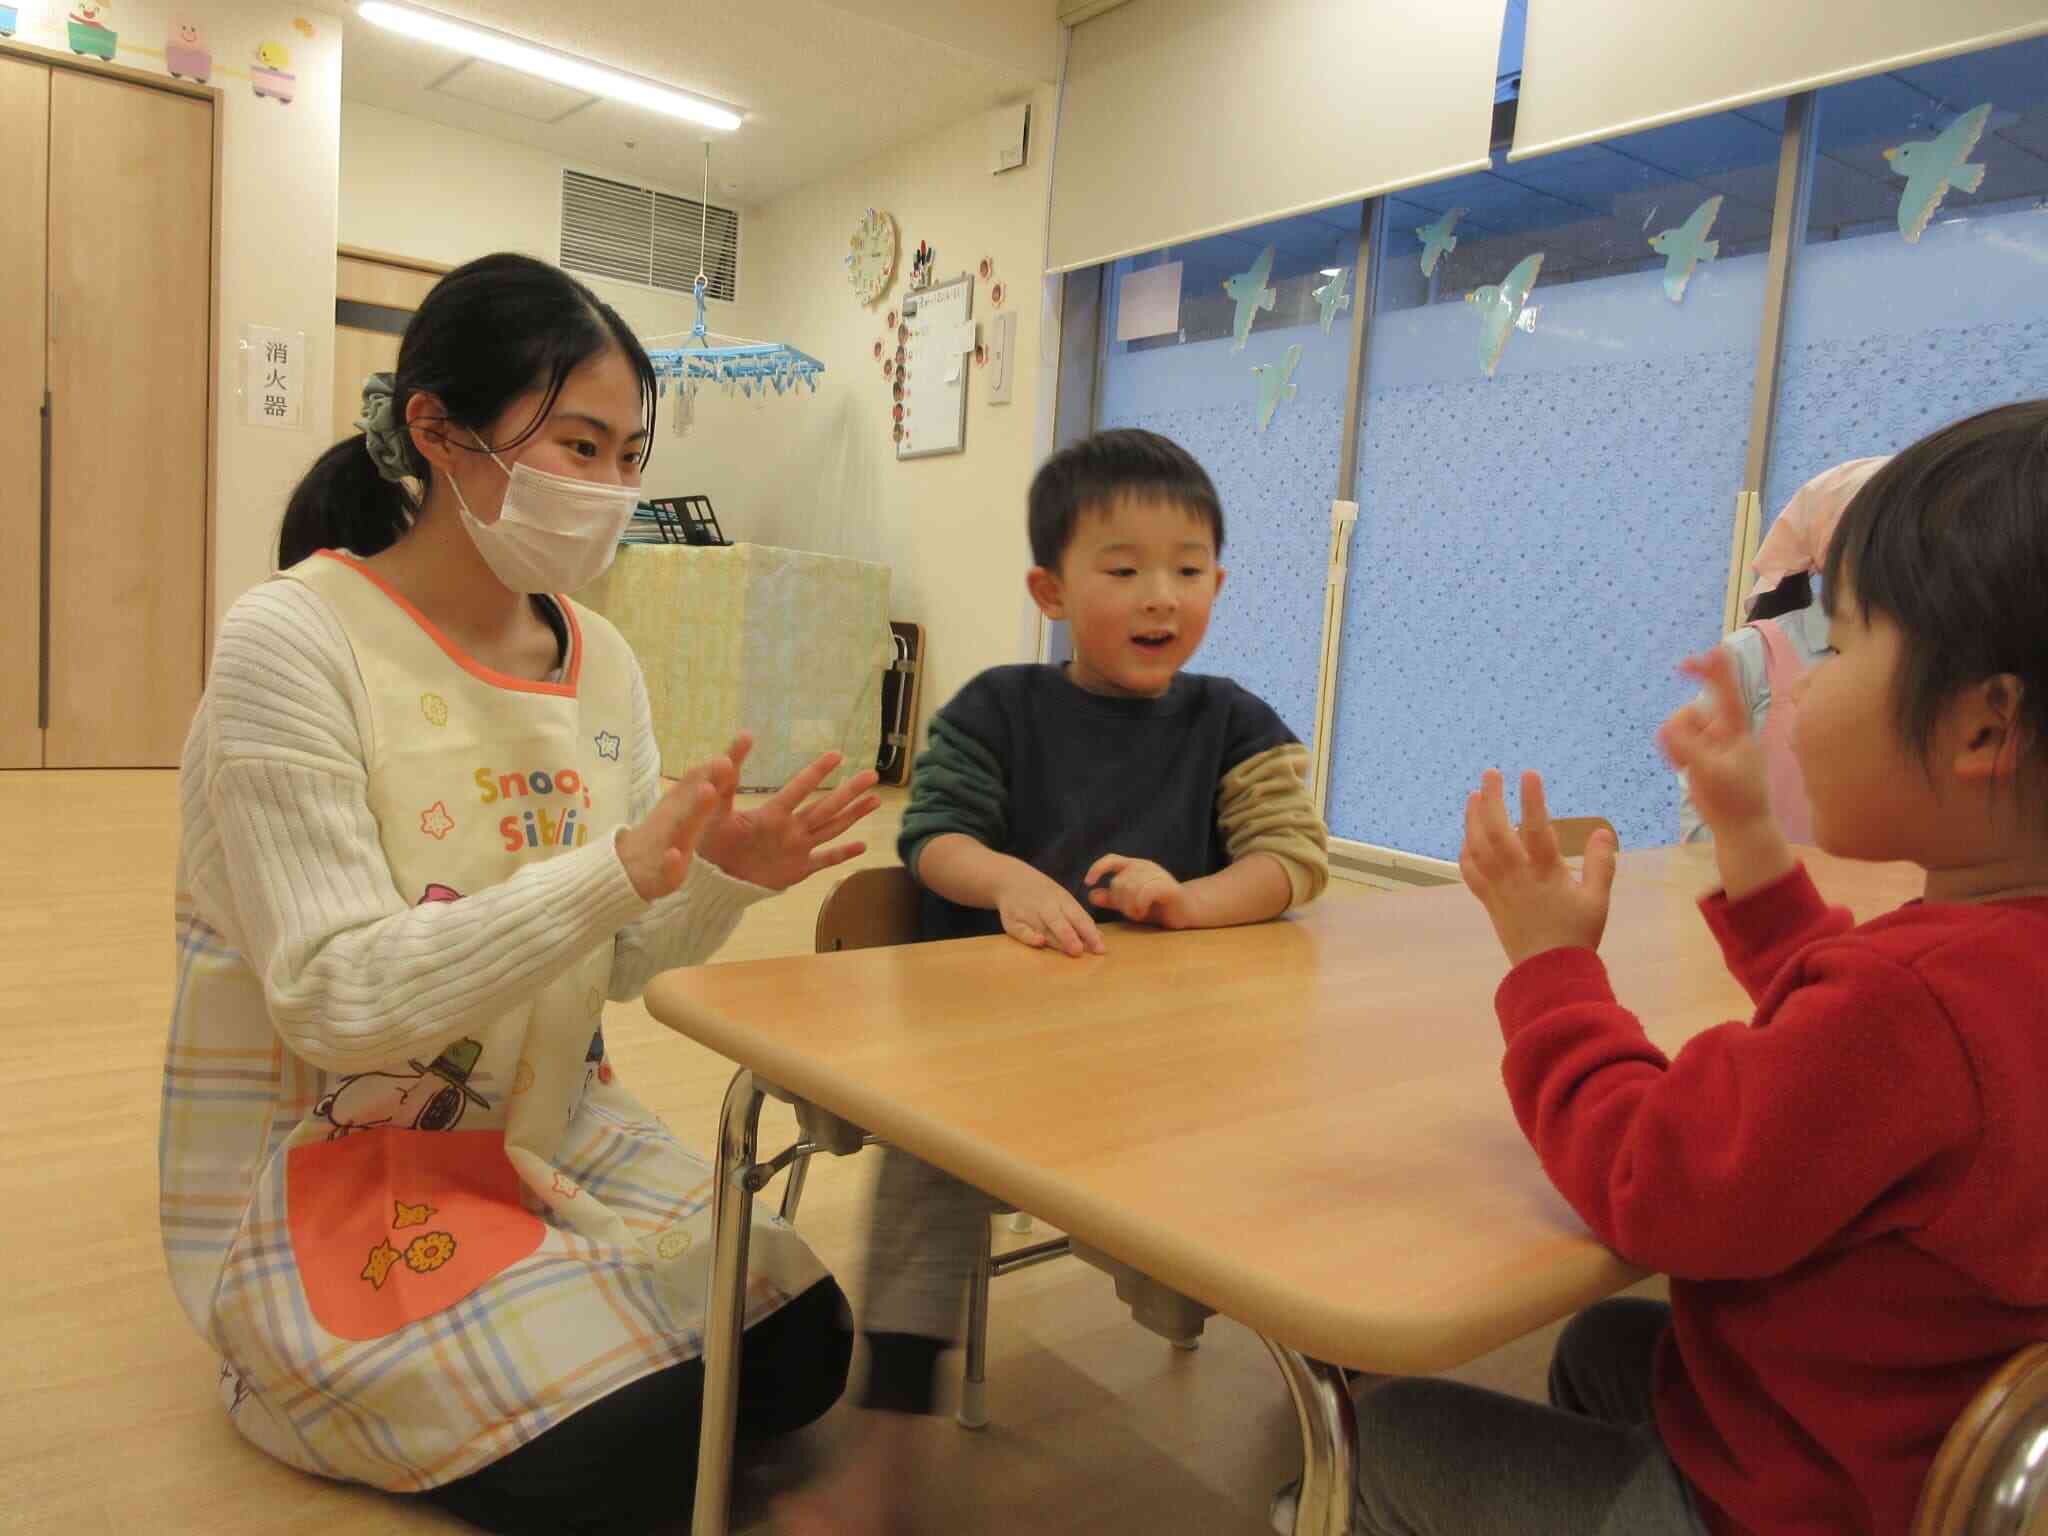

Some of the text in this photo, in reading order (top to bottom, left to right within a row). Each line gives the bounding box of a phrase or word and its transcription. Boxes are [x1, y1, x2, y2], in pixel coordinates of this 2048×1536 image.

[264, 341, 289, 417] 消火器
[474, 767, 592, 810] Snoo
